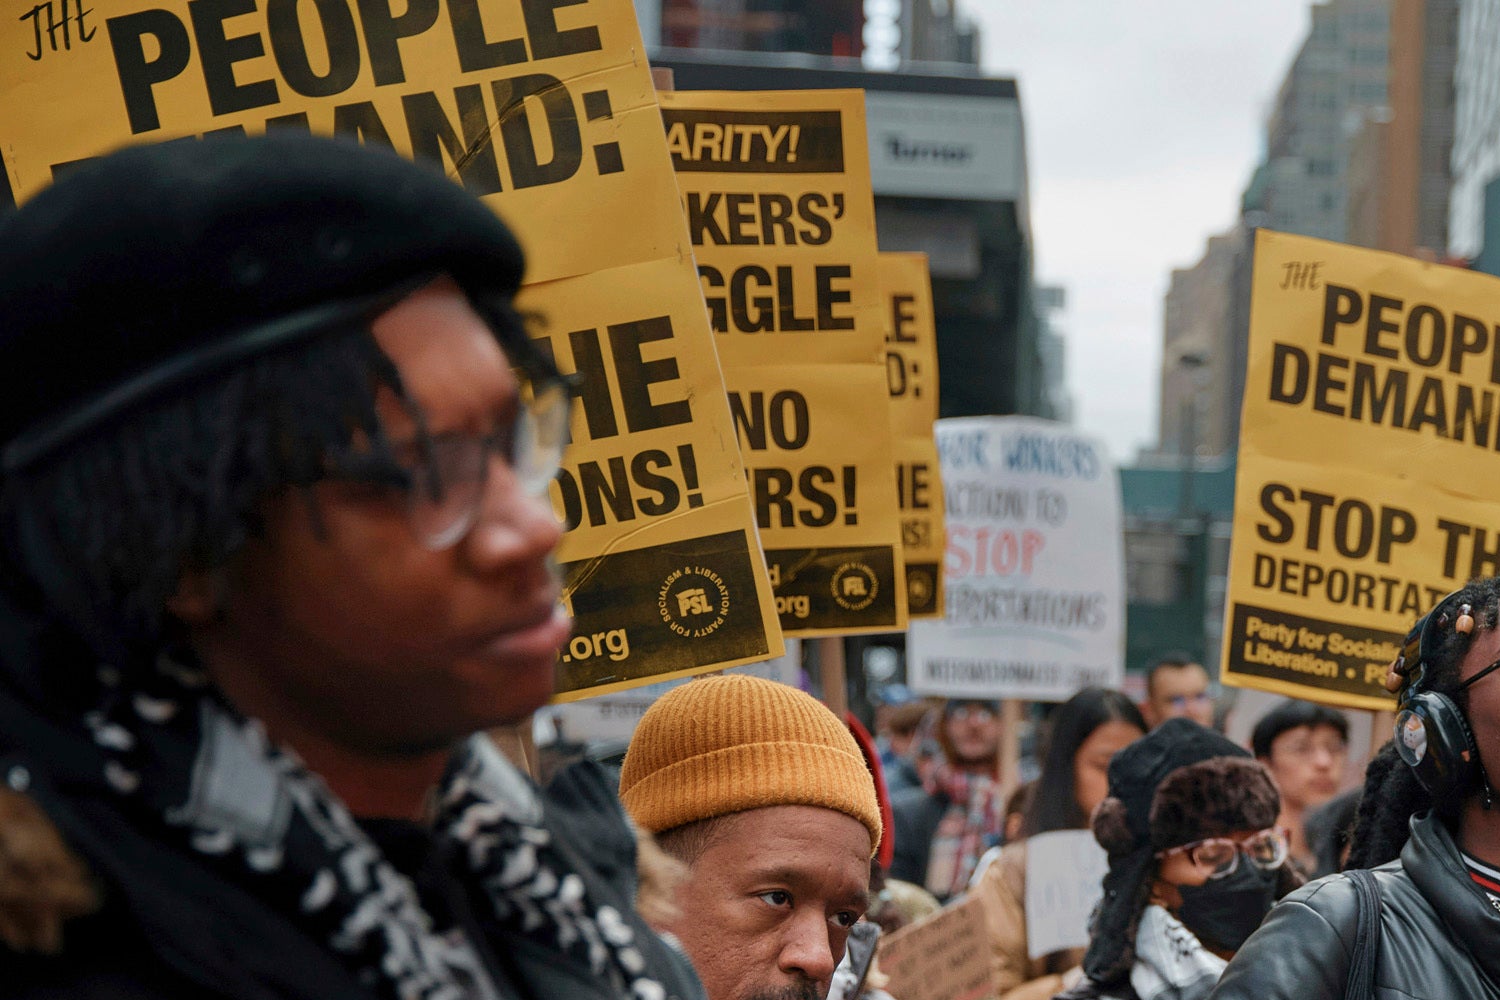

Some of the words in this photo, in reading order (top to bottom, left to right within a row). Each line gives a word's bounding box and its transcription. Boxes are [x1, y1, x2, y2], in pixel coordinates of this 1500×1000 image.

[1256, 482, 1418, 565] STOP
[945, 523, 1047, 580] STOP
[1246, 616, 1297, 650] Party
[1298, 626, 1327, 651] for
[1244, 640, 1340, 679] Liberation
